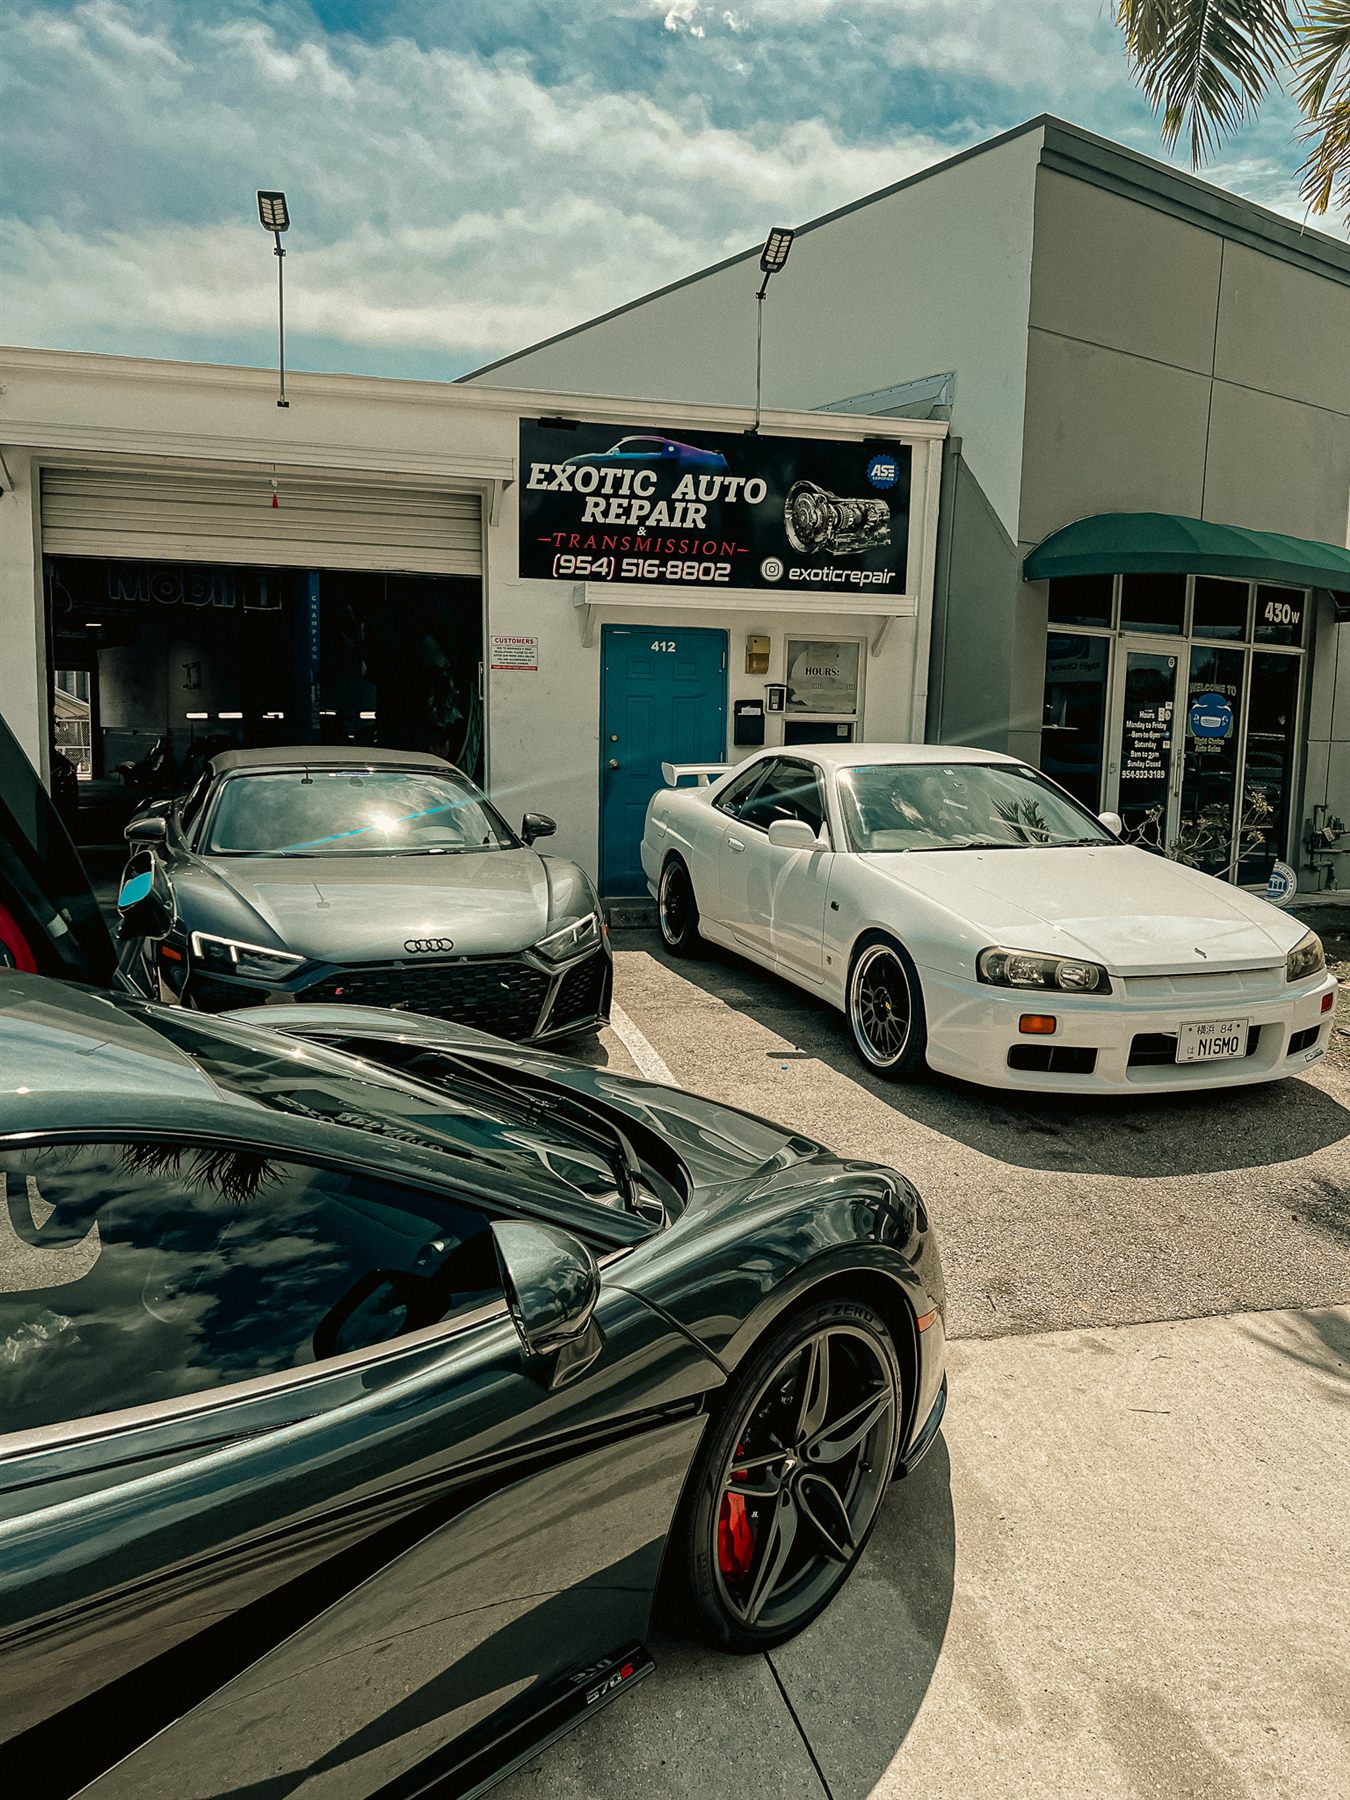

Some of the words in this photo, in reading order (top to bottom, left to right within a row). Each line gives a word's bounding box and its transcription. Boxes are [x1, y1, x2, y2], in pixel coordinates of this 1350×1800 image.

[871, 464, 895, 477] ASE
[526, 462, 657, 497] EXOTIC
[671, 473, 768, 505] AUTO
[581, 496, 708, 529] REPAIR
[637, 526, 646, 536] &
[552, 532, 737, 556] TRANSMISSION
[552, 553, 616, 580] (954)
[620, 558, 732, 582] 516-8802
[788, 566, 896, 587] exoticrepair
[494, 637, 534, 645] CUSTOMERS
[650, 641, 676, 652] 412
[805, 667, 840, 676] HOURS:
[1189, 682, 1226, 693] WELCOME
[1226, 684, 1237, 697] TO
[1139, 710, 1155, 719] Hours
[1126, 720, 1145, 730] Monday
[1152, 721, 1167, 730] Friday
[1134, 740, 1157, 750] Saturday
[1127, 760, 1145, 769] Sunday
[1145, 760, 1161, 768] Closed
[1220, 1023, 1233, 1034] 84
[1197, 1036, 1239, 1056] NISMO
[832, 1304, 875, 1323] ZERO
[585, 1662, 634, 1705] 570S
